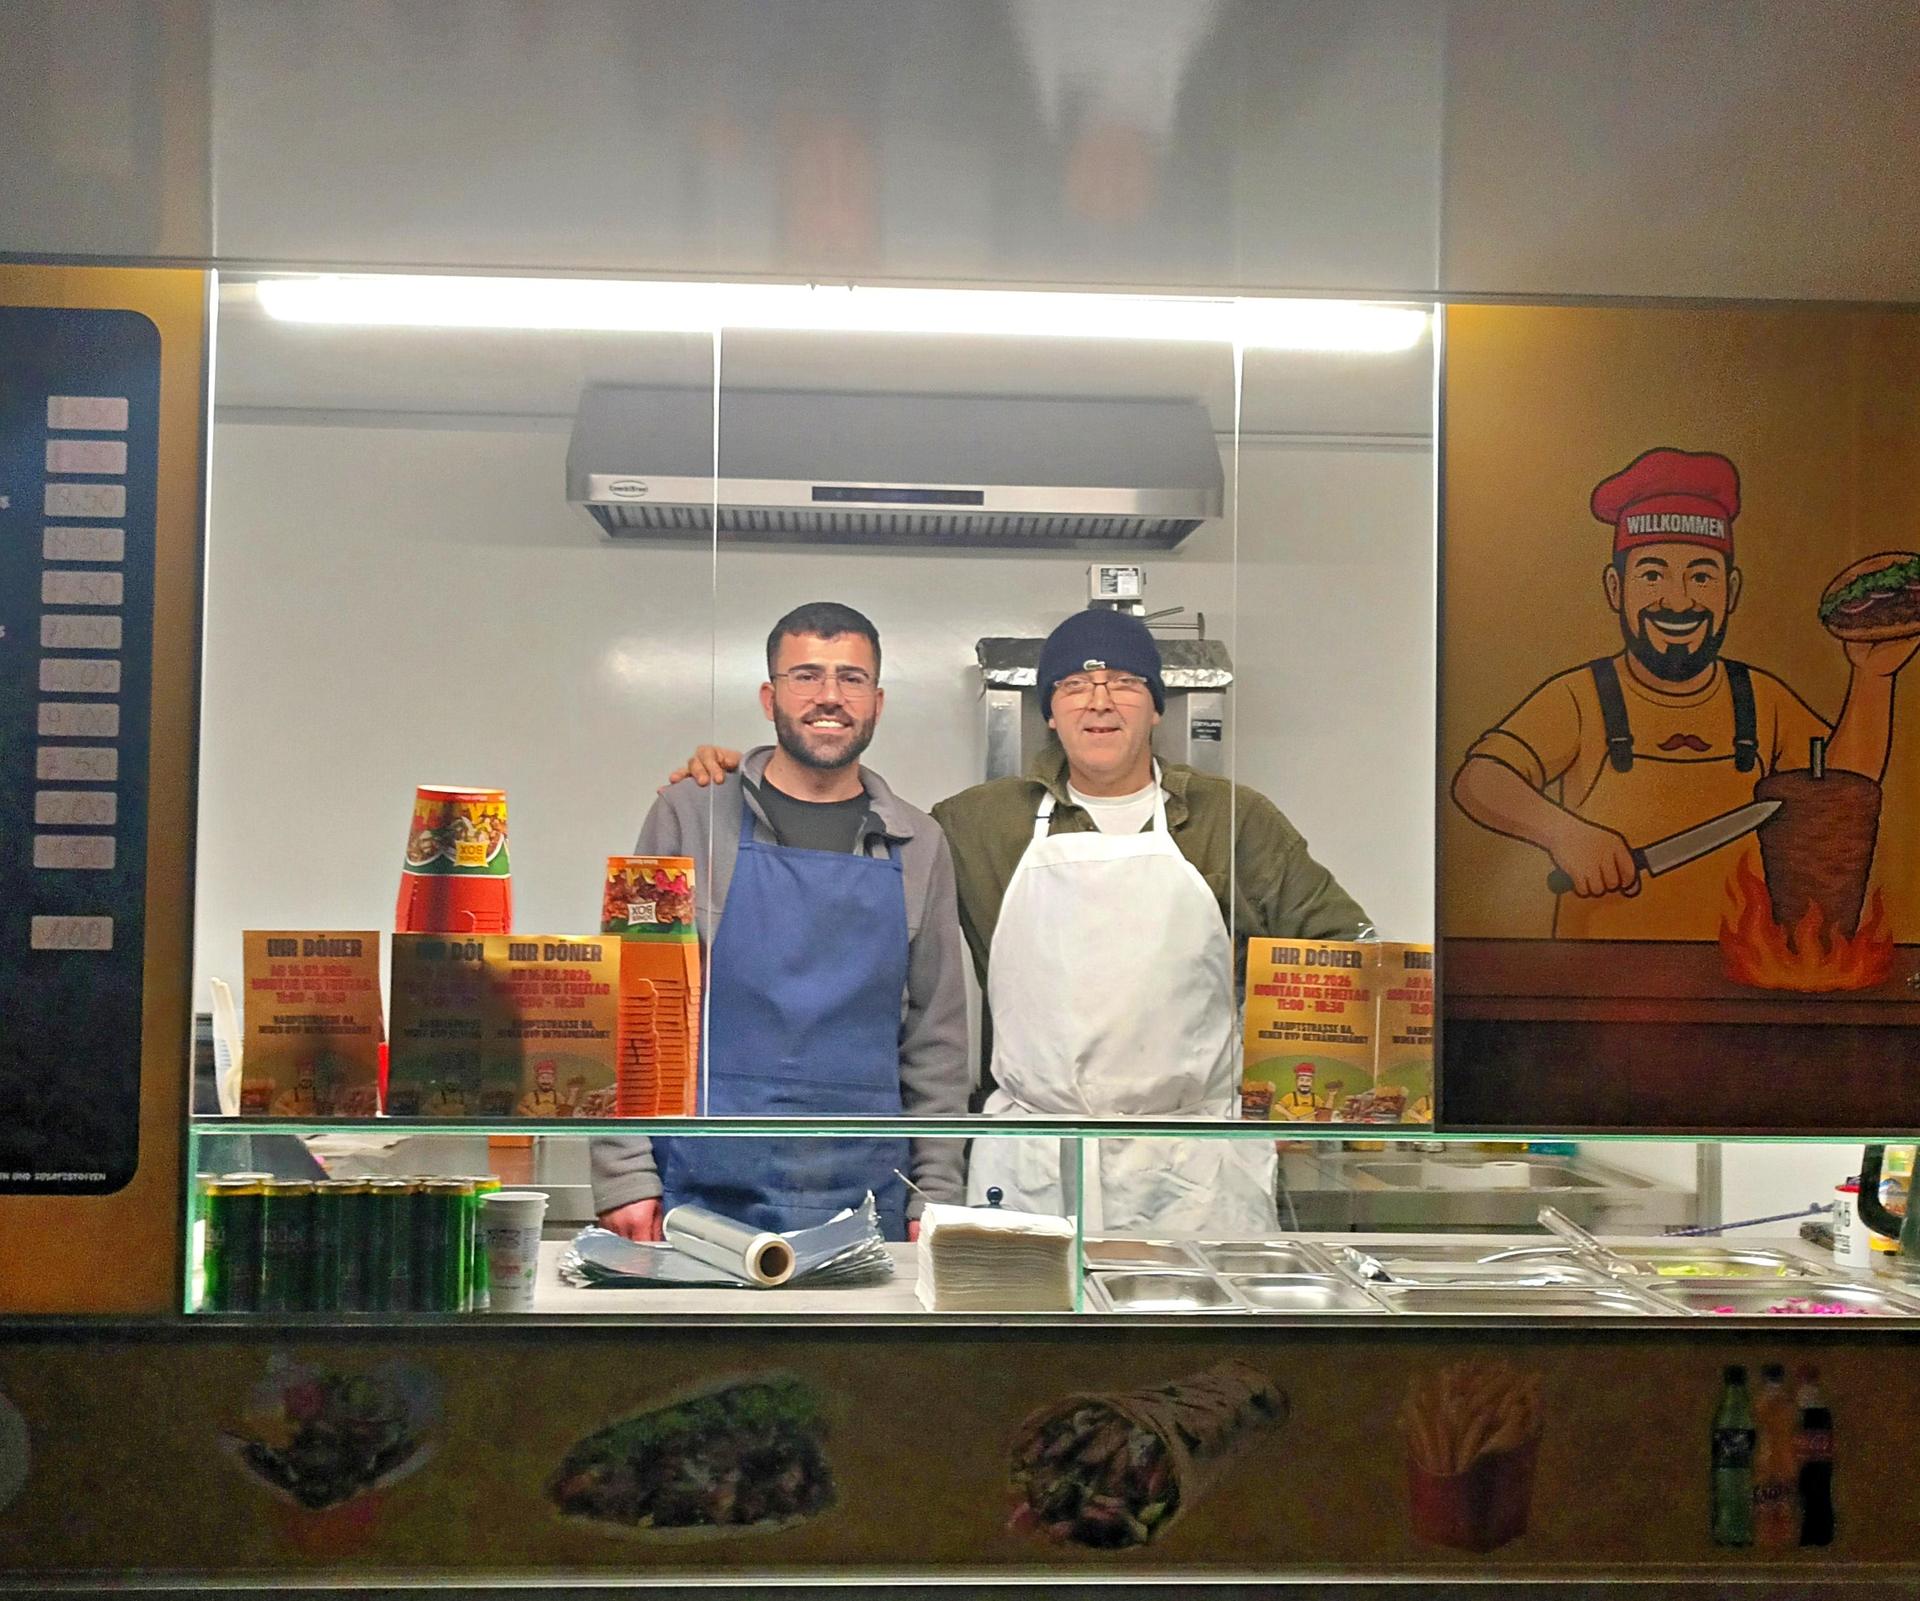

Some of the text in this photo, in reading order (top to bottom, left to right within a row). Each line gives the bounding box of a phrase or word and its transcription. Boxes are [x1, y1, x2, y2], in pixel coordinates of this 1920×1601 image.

[1626, 513, 1725, 539] WILLKOMMEN
[631, 905, 653, 915] BOX
[303, 934, 362, 957] DÖNER
[509, 939, 602, 962] IHR DÖNER
[1271, 944, 1363, 969] IHR DÖNER
[1273, 971, 1352, 988] AB 16.02.2026
[1254, 984, 1371, 1002] MONTAG BIS FREITAG
